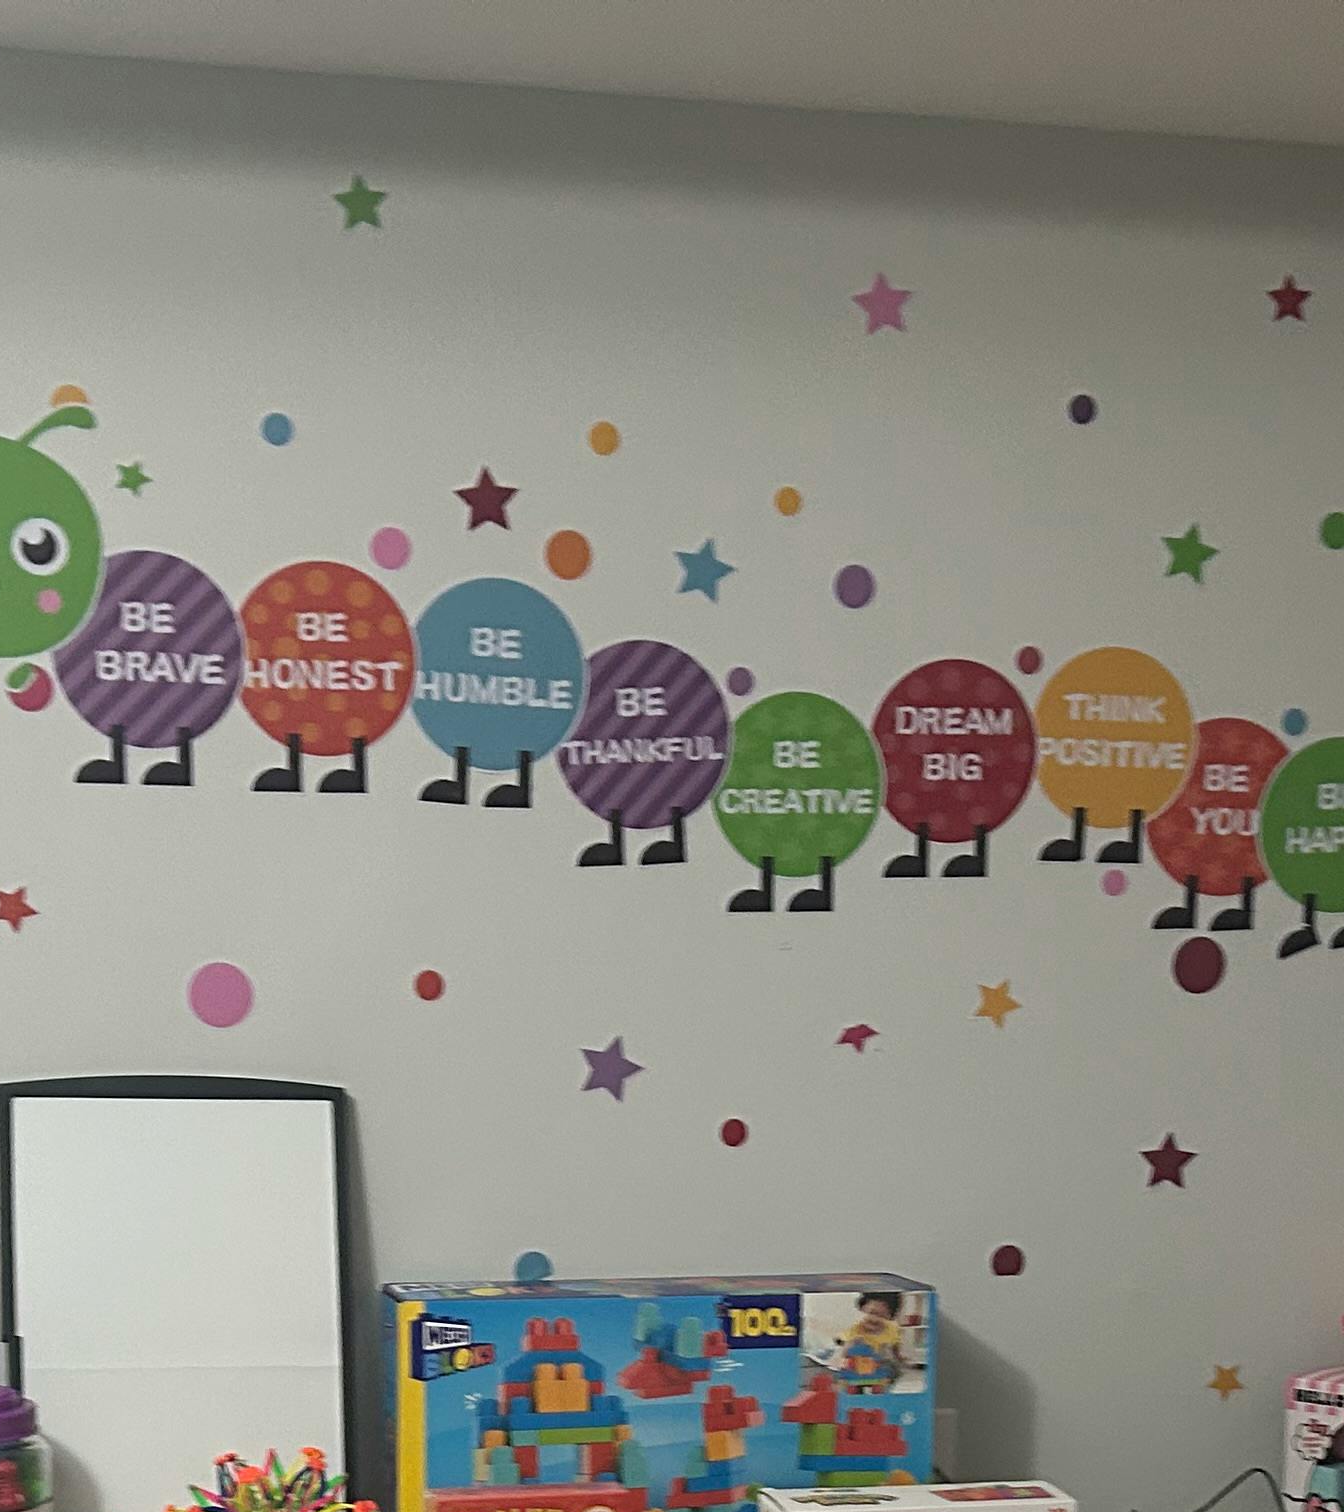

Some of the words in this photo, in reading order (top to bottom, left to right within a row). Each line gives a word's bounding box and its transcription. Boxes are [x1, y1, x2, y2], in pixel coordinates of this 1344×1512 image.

[120, 600, 176, 634] BE
[296, 611, 350, 643] BE
[470, 627, 523, 659] BE
[94, 650, 226, 686] BRAVE
[246, 658, 404, 693] HONEST
[417, 674, 574, 711] HUMBLE
[614, 686, 668, 719] BE
[1062, 692, 1166, 724] THINK
[895, 706, 1014, 737] DREAM
[560, 735, 724, 763] THANKFUL
[772, 740, 822, 770] BE
[1038, 736, 1186, 770] POSITIVE
[922, 753, 984, 783] BIG
[1202, 763, 1250, 793] BE
[719, 787, 874, 816] CREATIVE
[1190, 807, 1259, 838] YOU
[728, 1307, 788, 1337] 100
